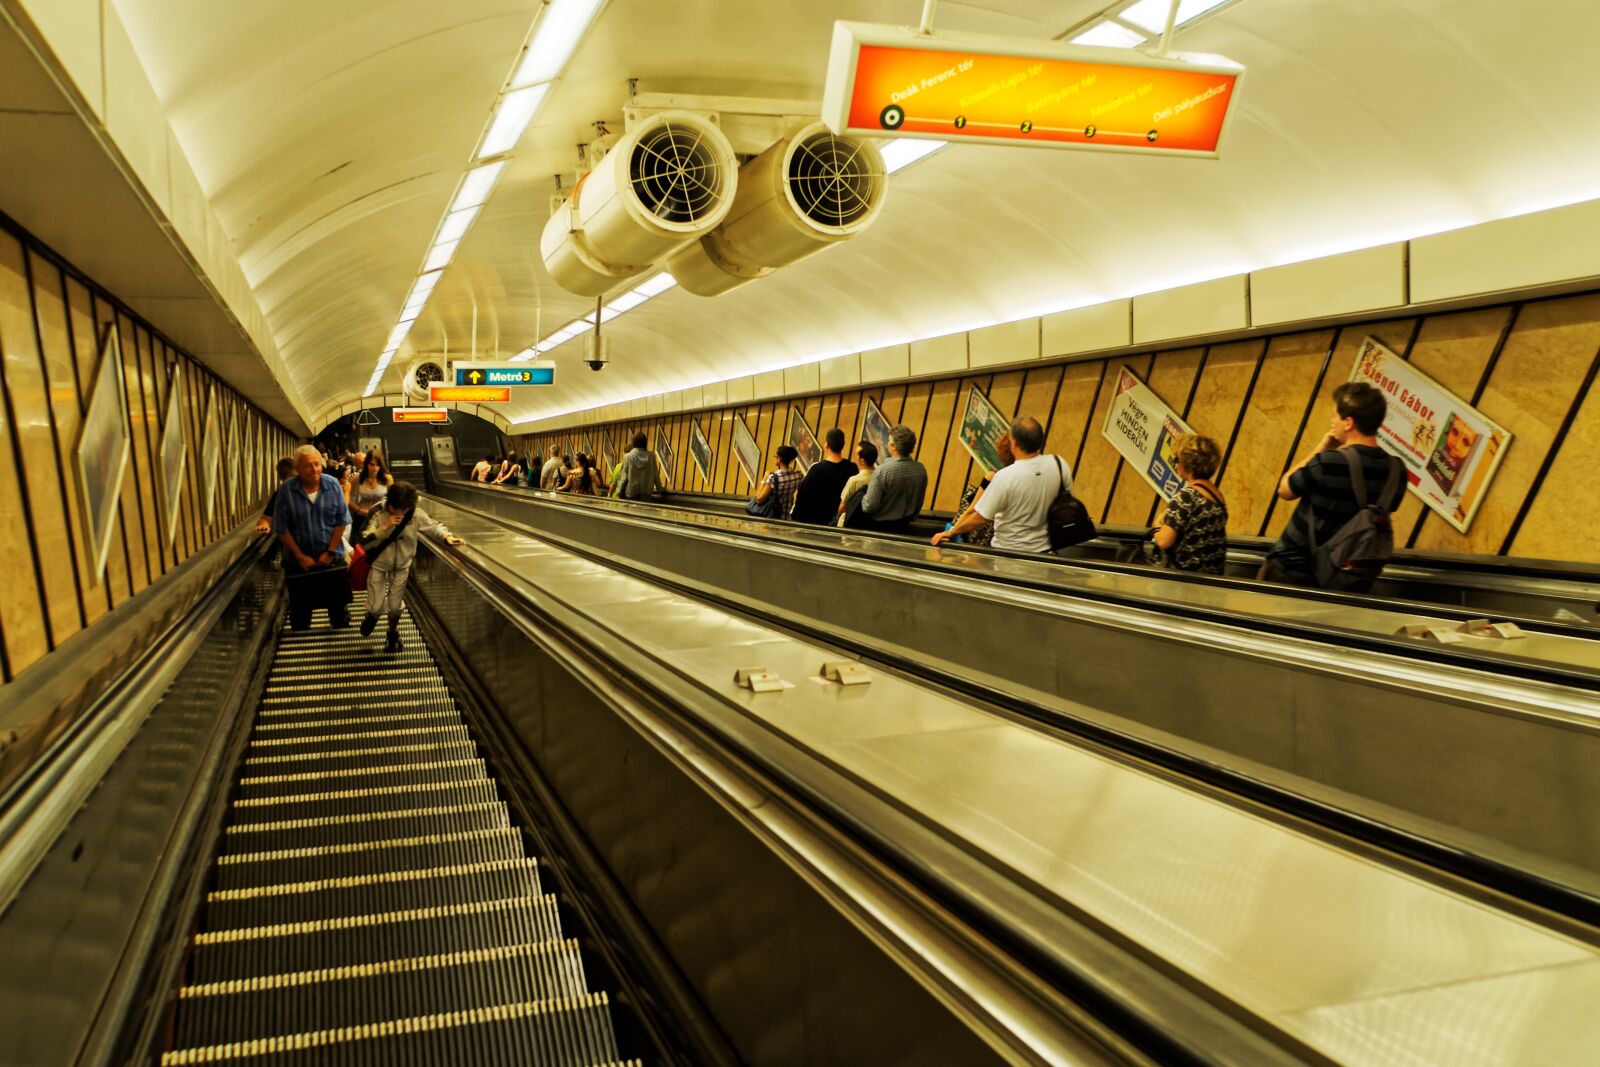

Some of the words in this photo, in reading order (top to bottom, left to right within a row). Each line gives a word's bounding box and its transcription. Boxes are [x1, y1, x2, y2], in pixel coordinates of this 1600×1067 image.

[891, 83, 920, 104] Deák
[920, 67, 957, 90] Ferenc
[958, 58, 975, 73] tér
[1022, 122, 1030, 132] 2
[1086, 127, 1094, 136] 3
[1362, 362, 1399, 396] Szendi
[1399, 388, 1435, 422] Gábor
[1121, 409, 1149, 441] MINDEN
[1128, 396, 1148, 424] Végre
